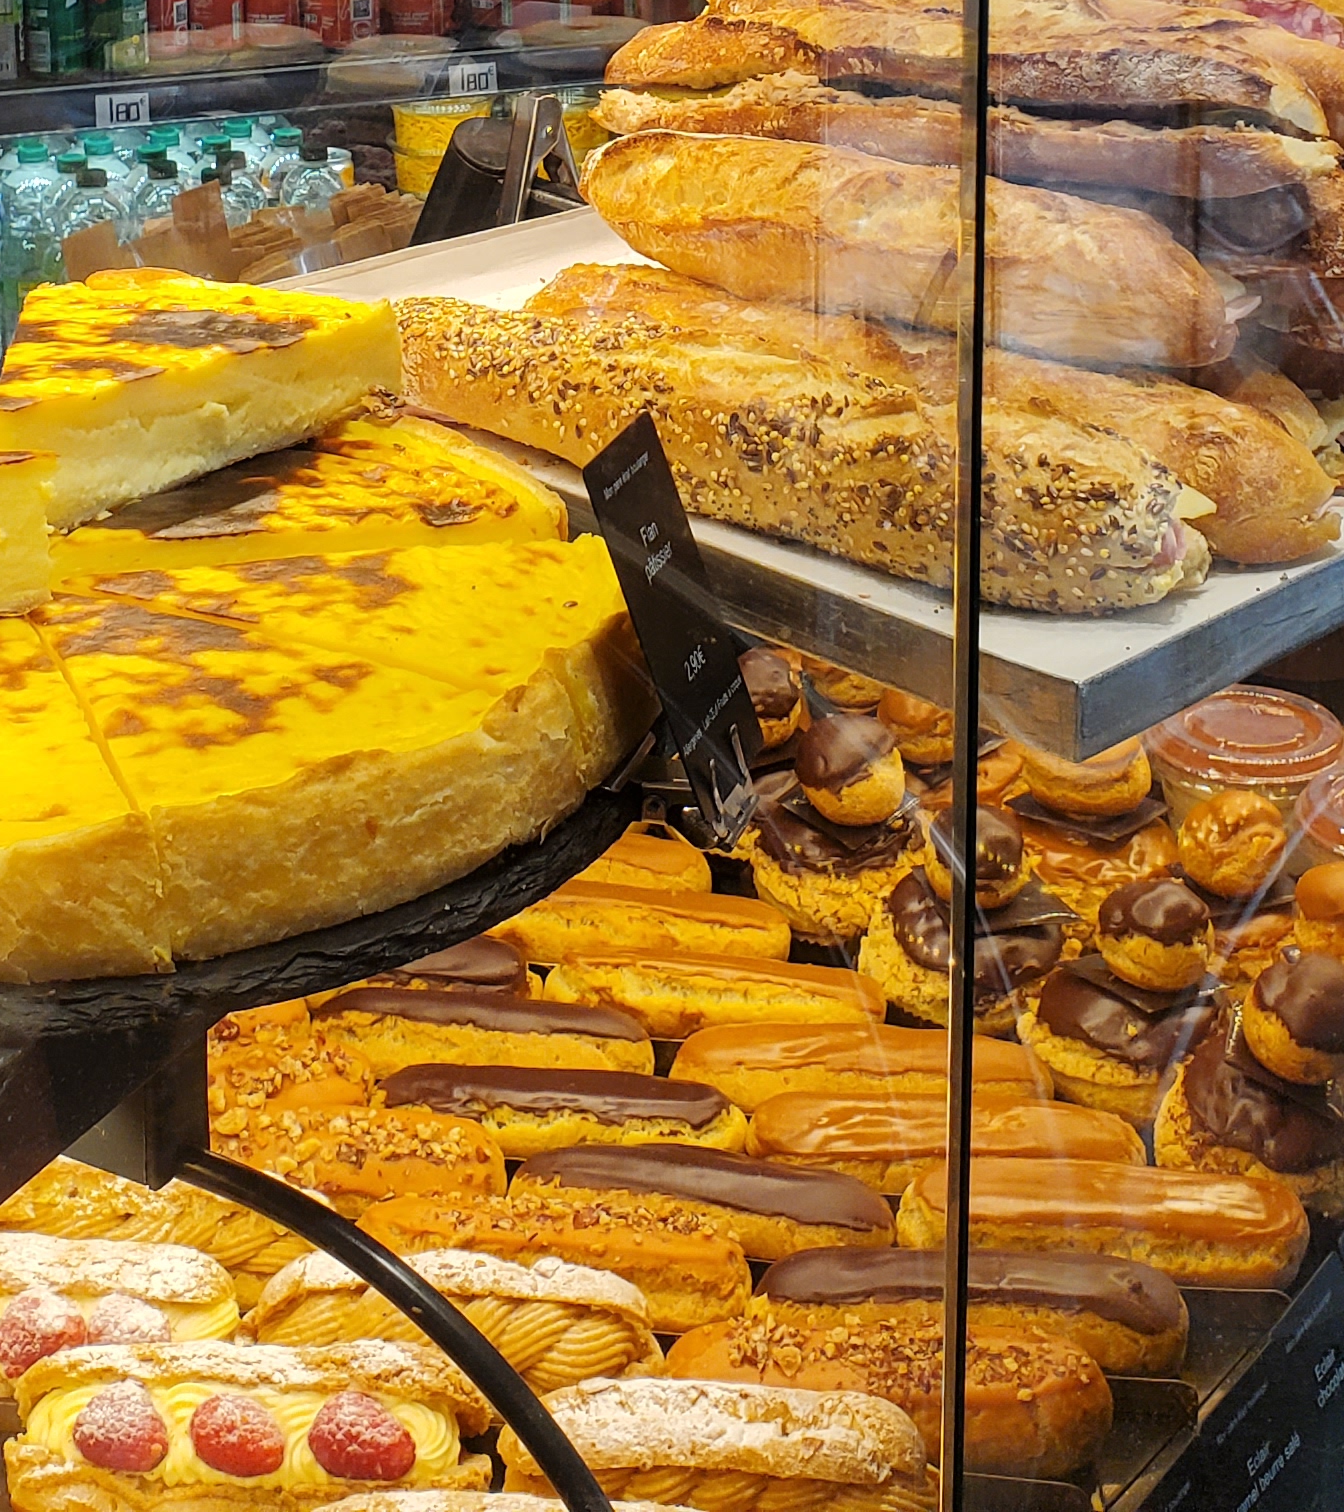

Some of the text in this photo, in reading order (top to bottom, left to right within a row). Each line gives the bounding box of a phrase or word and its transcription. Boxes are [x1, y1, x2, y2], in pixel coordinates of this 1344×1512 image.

[640, 522, 659, 548] Flan
[644, 540, 672, 586] pâtissier
[1314, 1349, 1336, 1383] Eclair
[1247, 1440, 1271, 1478] Eclair
[1258, 1429, 1301, 1493] beurre salé
